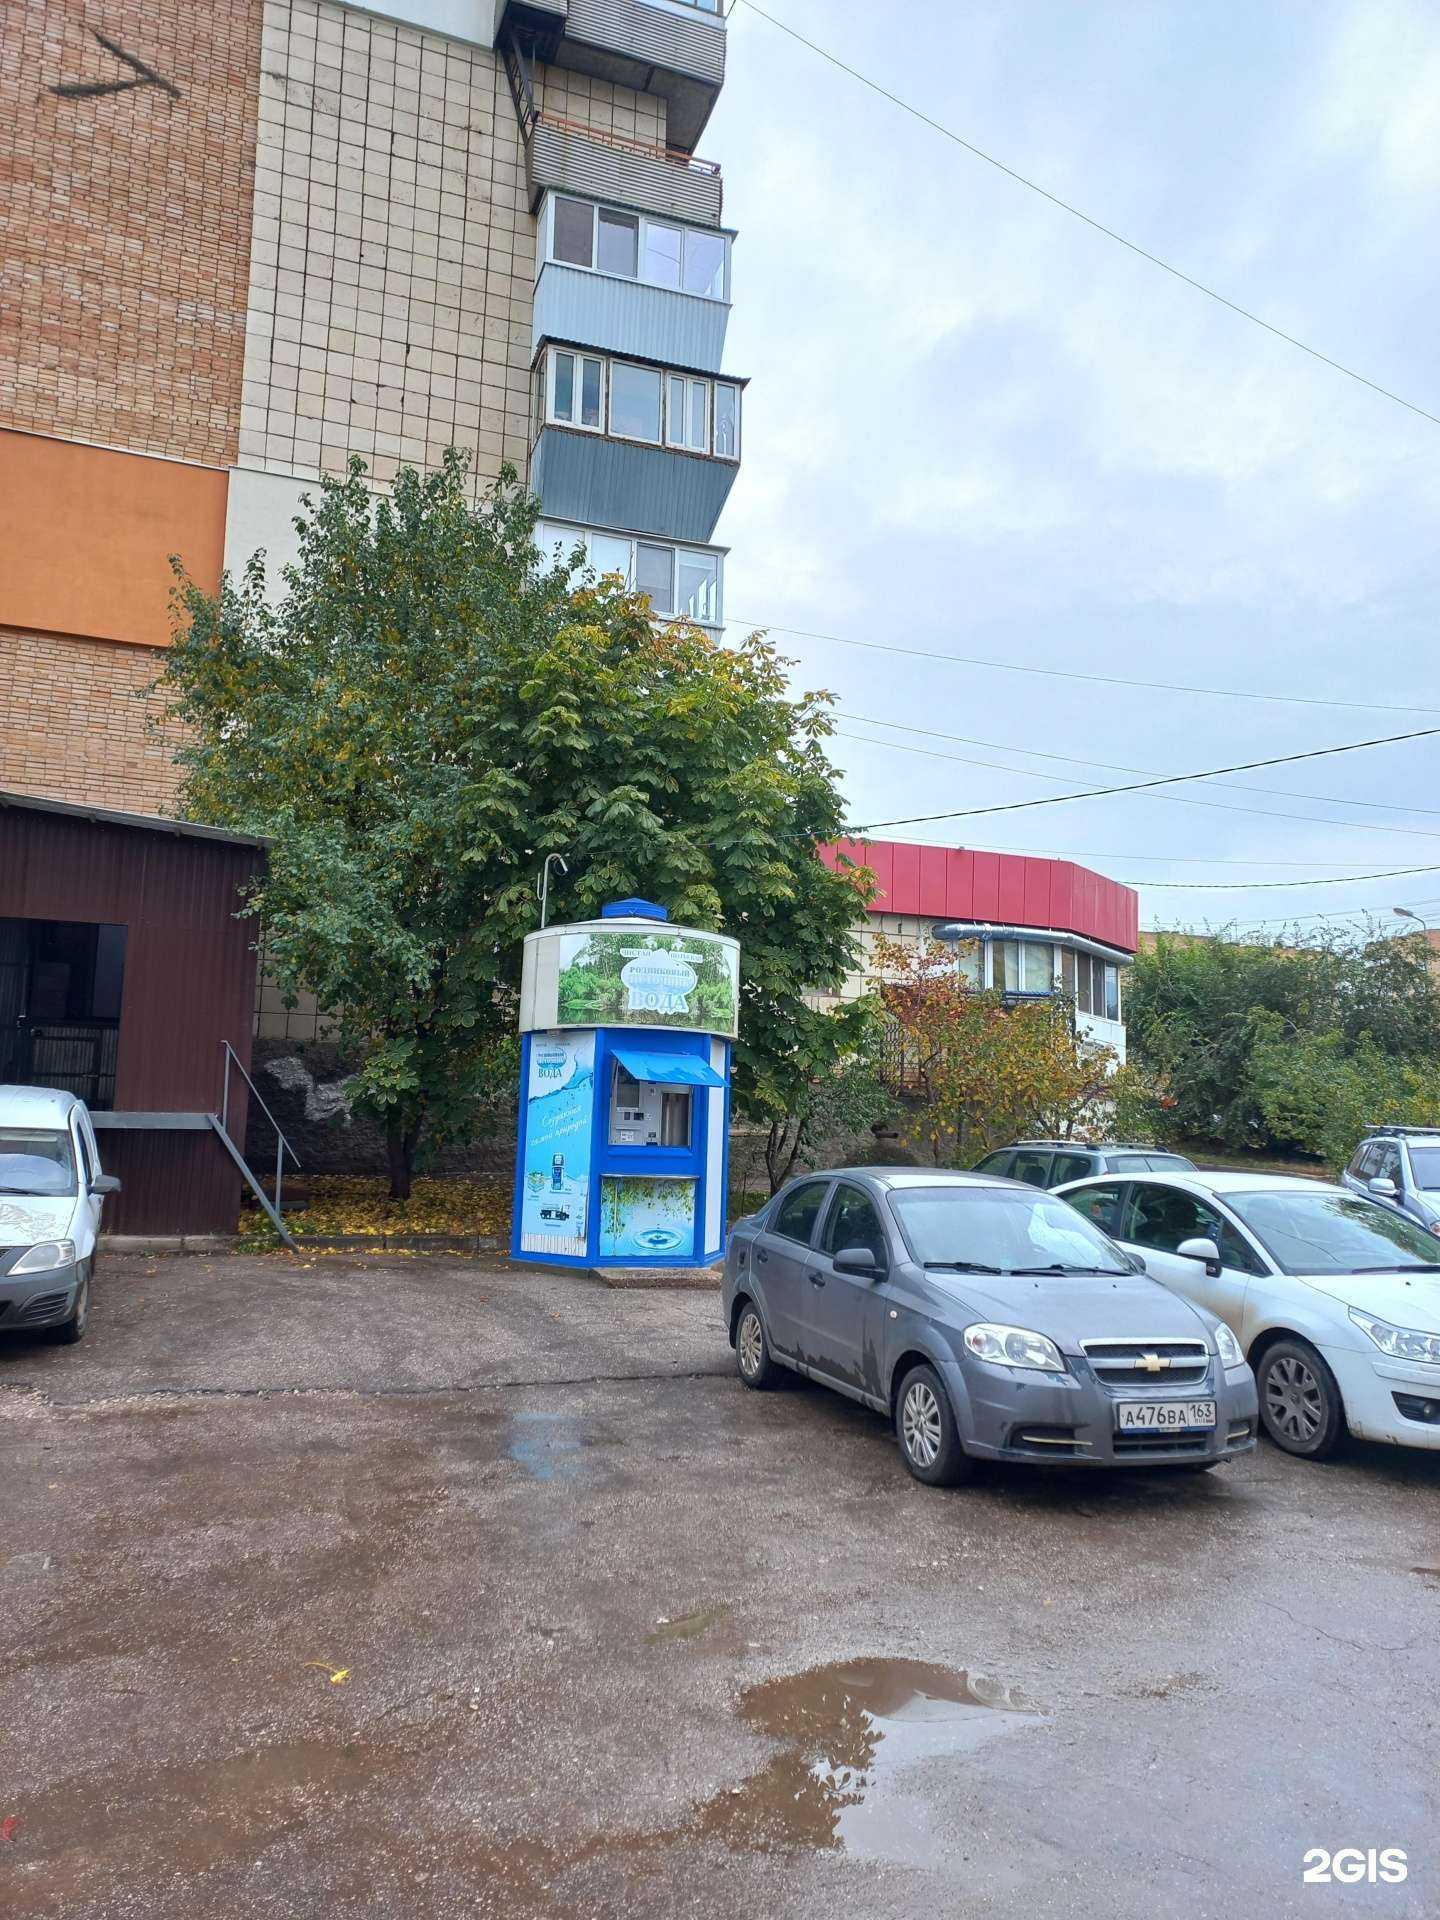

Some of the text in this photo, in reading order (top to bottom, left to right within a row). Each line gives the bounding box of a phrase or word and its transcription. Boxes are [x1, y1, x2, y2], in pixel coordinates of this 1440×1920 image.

[632, 991, 687, 1011] ВОДА
[538, 1068, 562, 1079] ВОДА
[1190, 1404, 1212, 1418] 163
